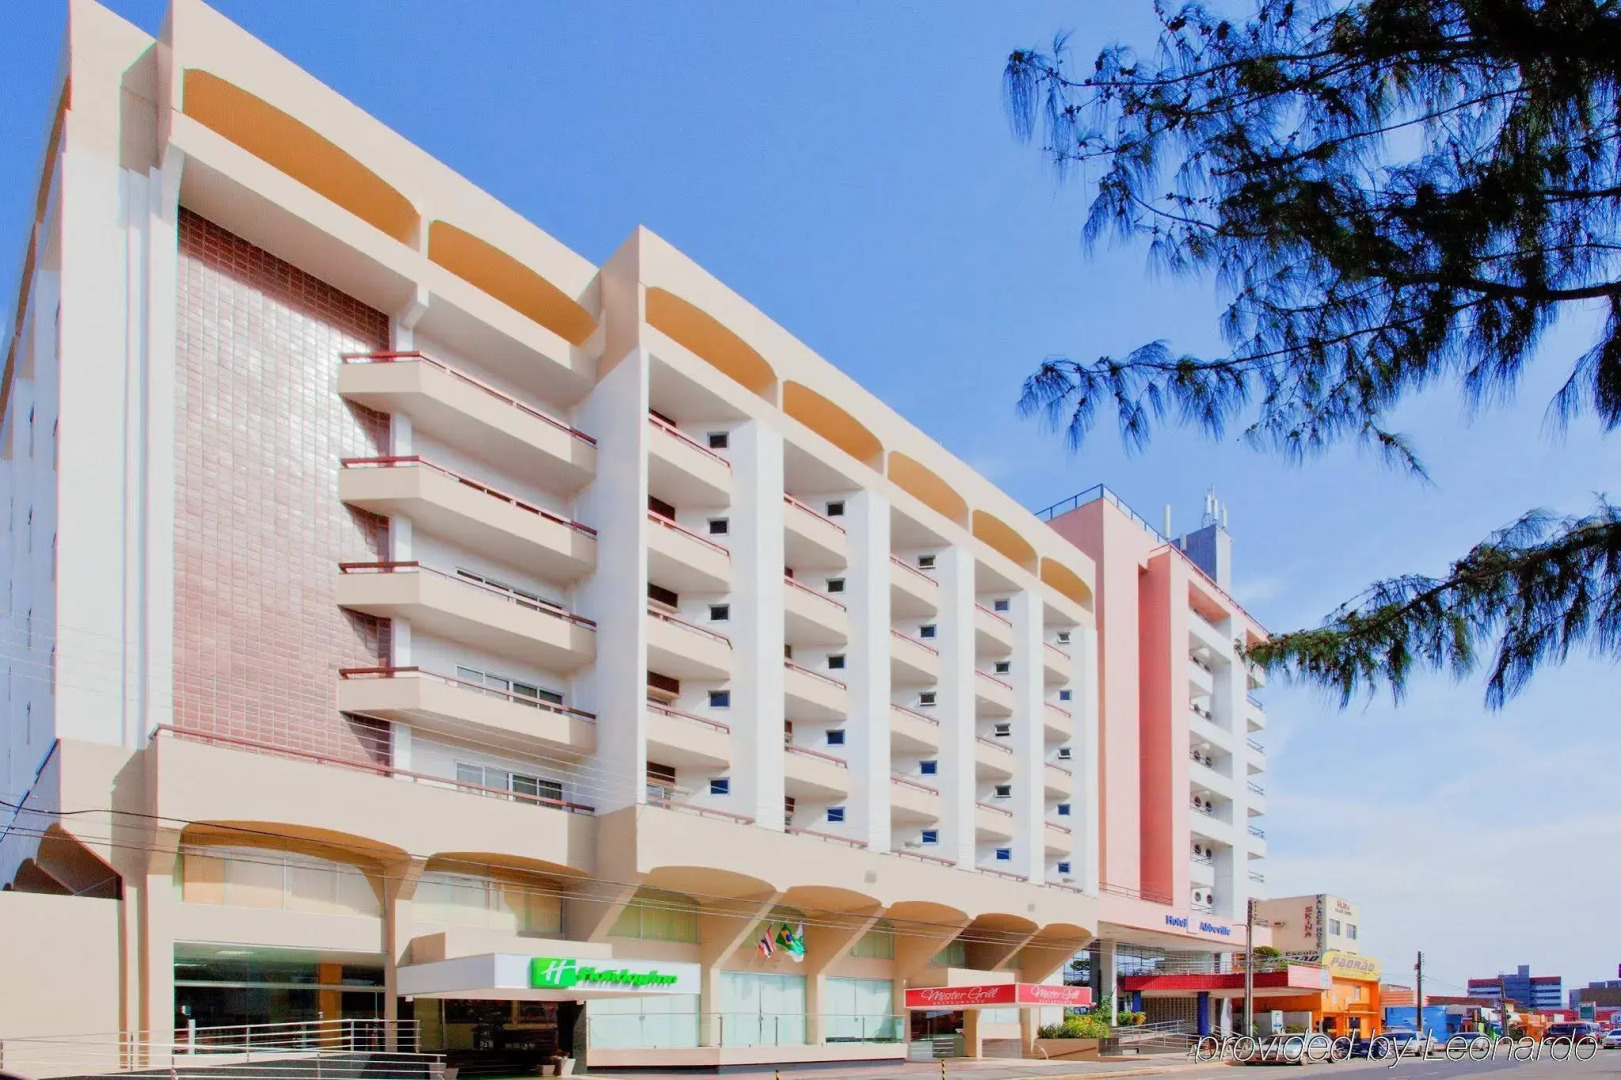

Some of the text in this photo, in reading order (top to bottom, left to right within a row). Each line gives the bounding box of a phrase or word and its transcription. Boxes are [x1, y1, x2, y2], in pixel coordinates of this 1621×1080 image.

[1285, 949, 1318, 957] Escola
[920, 985, 999, 1001] Mister Grill
[1030, 985, 1061, 999] Mister
